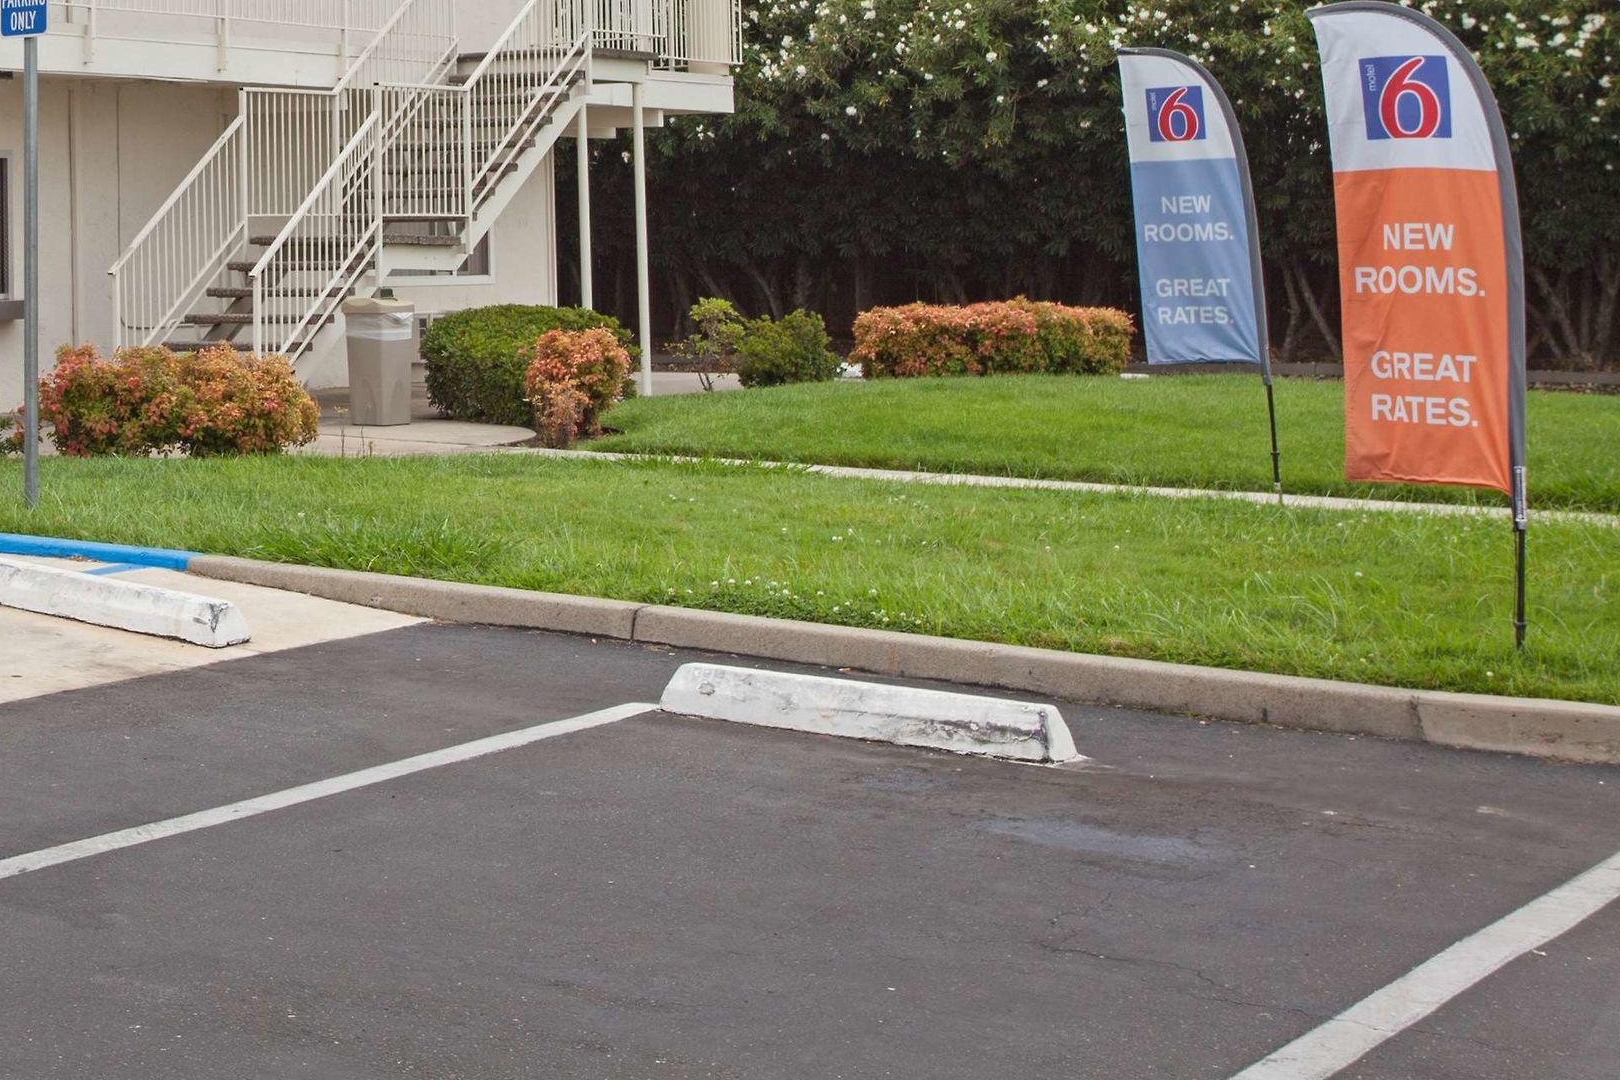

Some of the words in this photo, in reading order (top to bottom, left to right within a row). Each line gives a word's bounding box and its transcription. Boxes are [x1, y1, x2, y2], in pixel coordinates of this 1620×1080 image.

[10, 10, 37, 31] ONLY
[1365, 64, 1377, 92] motel
[1379, 56, 1441, 140] 6
[1158, 86, 1199, 142] 6
[1160, 195, 1211, 213] NEW
[1144, 222, 1235, 242] ROOMS.
[1383, 222, 1454, 251] NEW
[1156, 278, 1230, 297] GREAT
[1354, 265, 1486, 297] ROOMS.
[1157, 306, 1234, 325] RATES.
[1371, 350, 1477, 383] GREAT
[1371, 393, 1478, 428] RATES.
